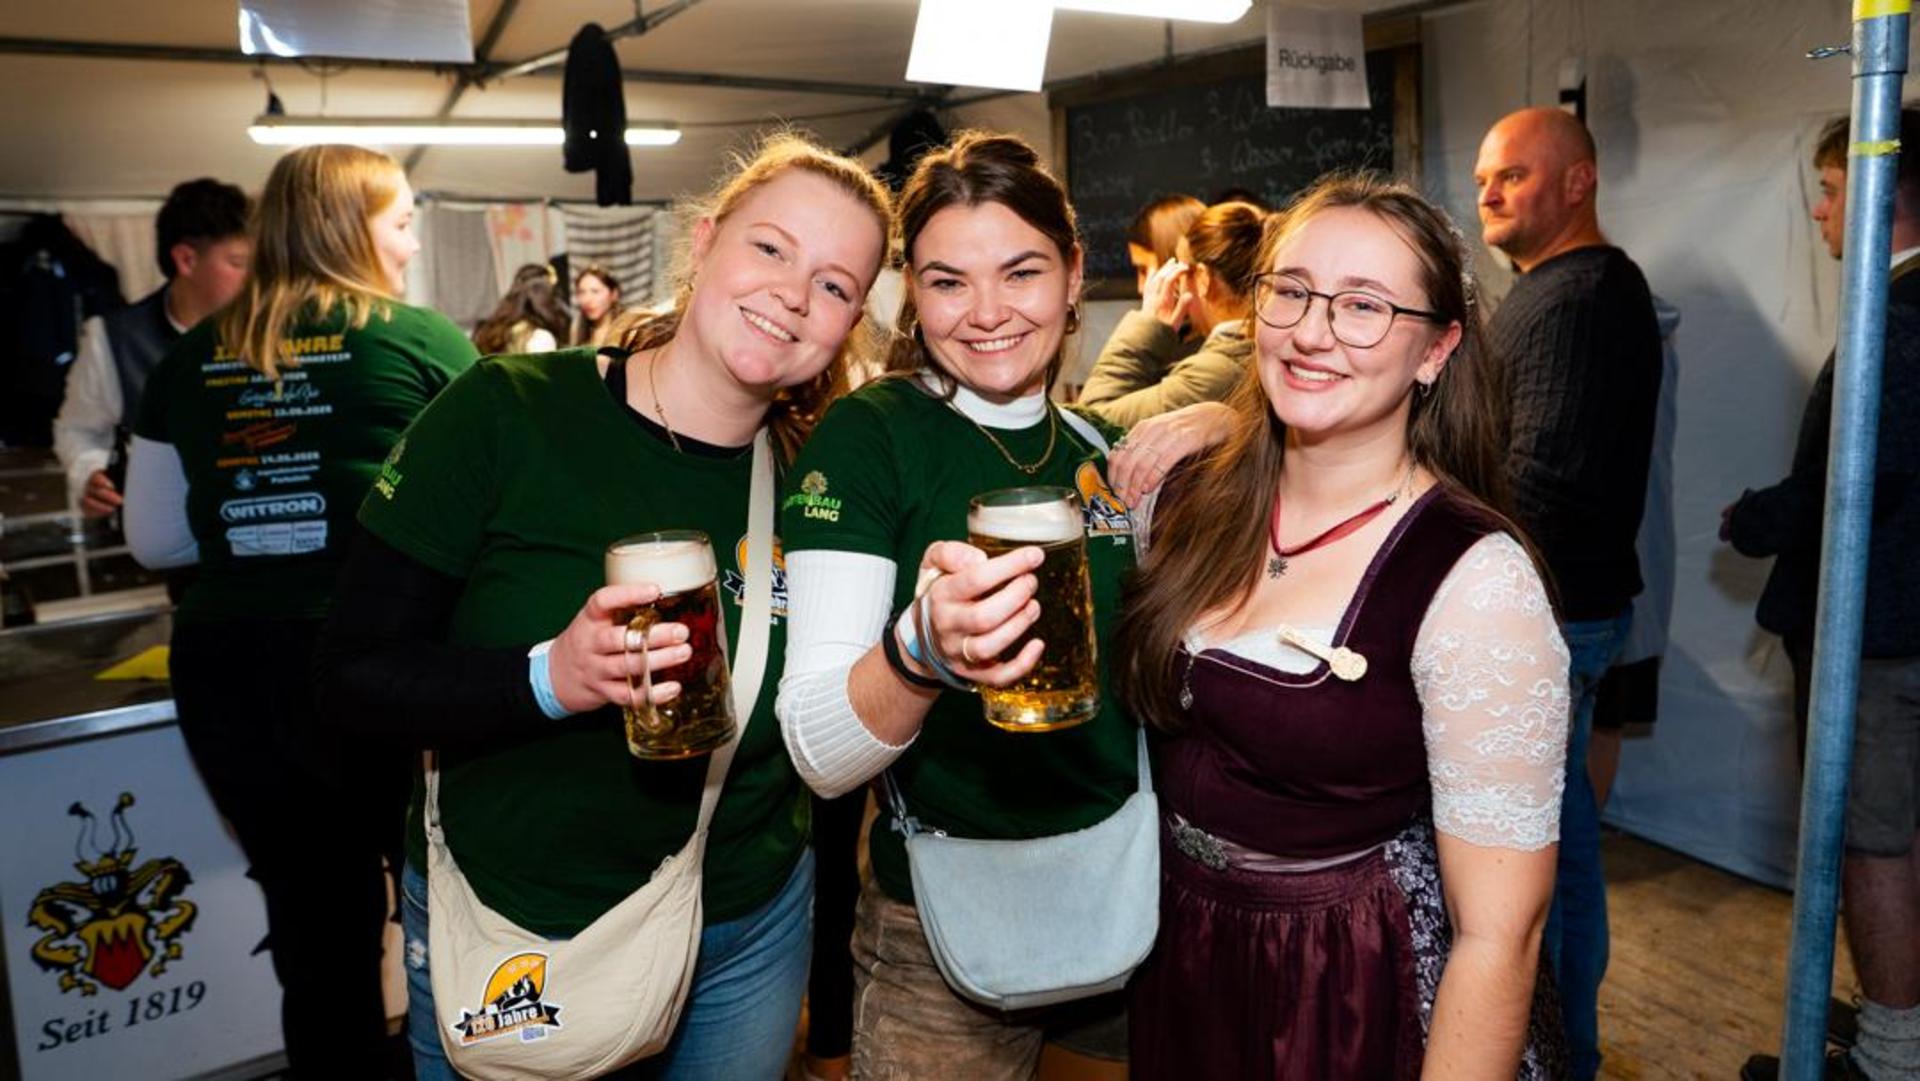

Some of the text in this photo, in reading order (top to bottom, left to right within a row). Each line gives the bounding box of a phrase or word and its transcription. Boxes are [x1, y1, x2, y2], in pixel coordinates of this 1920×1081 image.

[1279, 48, 1355, 74] Rückgabe
[283, 335, 344, 355] AHRE
[227, 499, 318, 519] WITRON
[804, 506, 840, 522] LANG
[37, 980, 207, 1052] Seit 1819
[498, 1006, 538, 1029] Jahre
